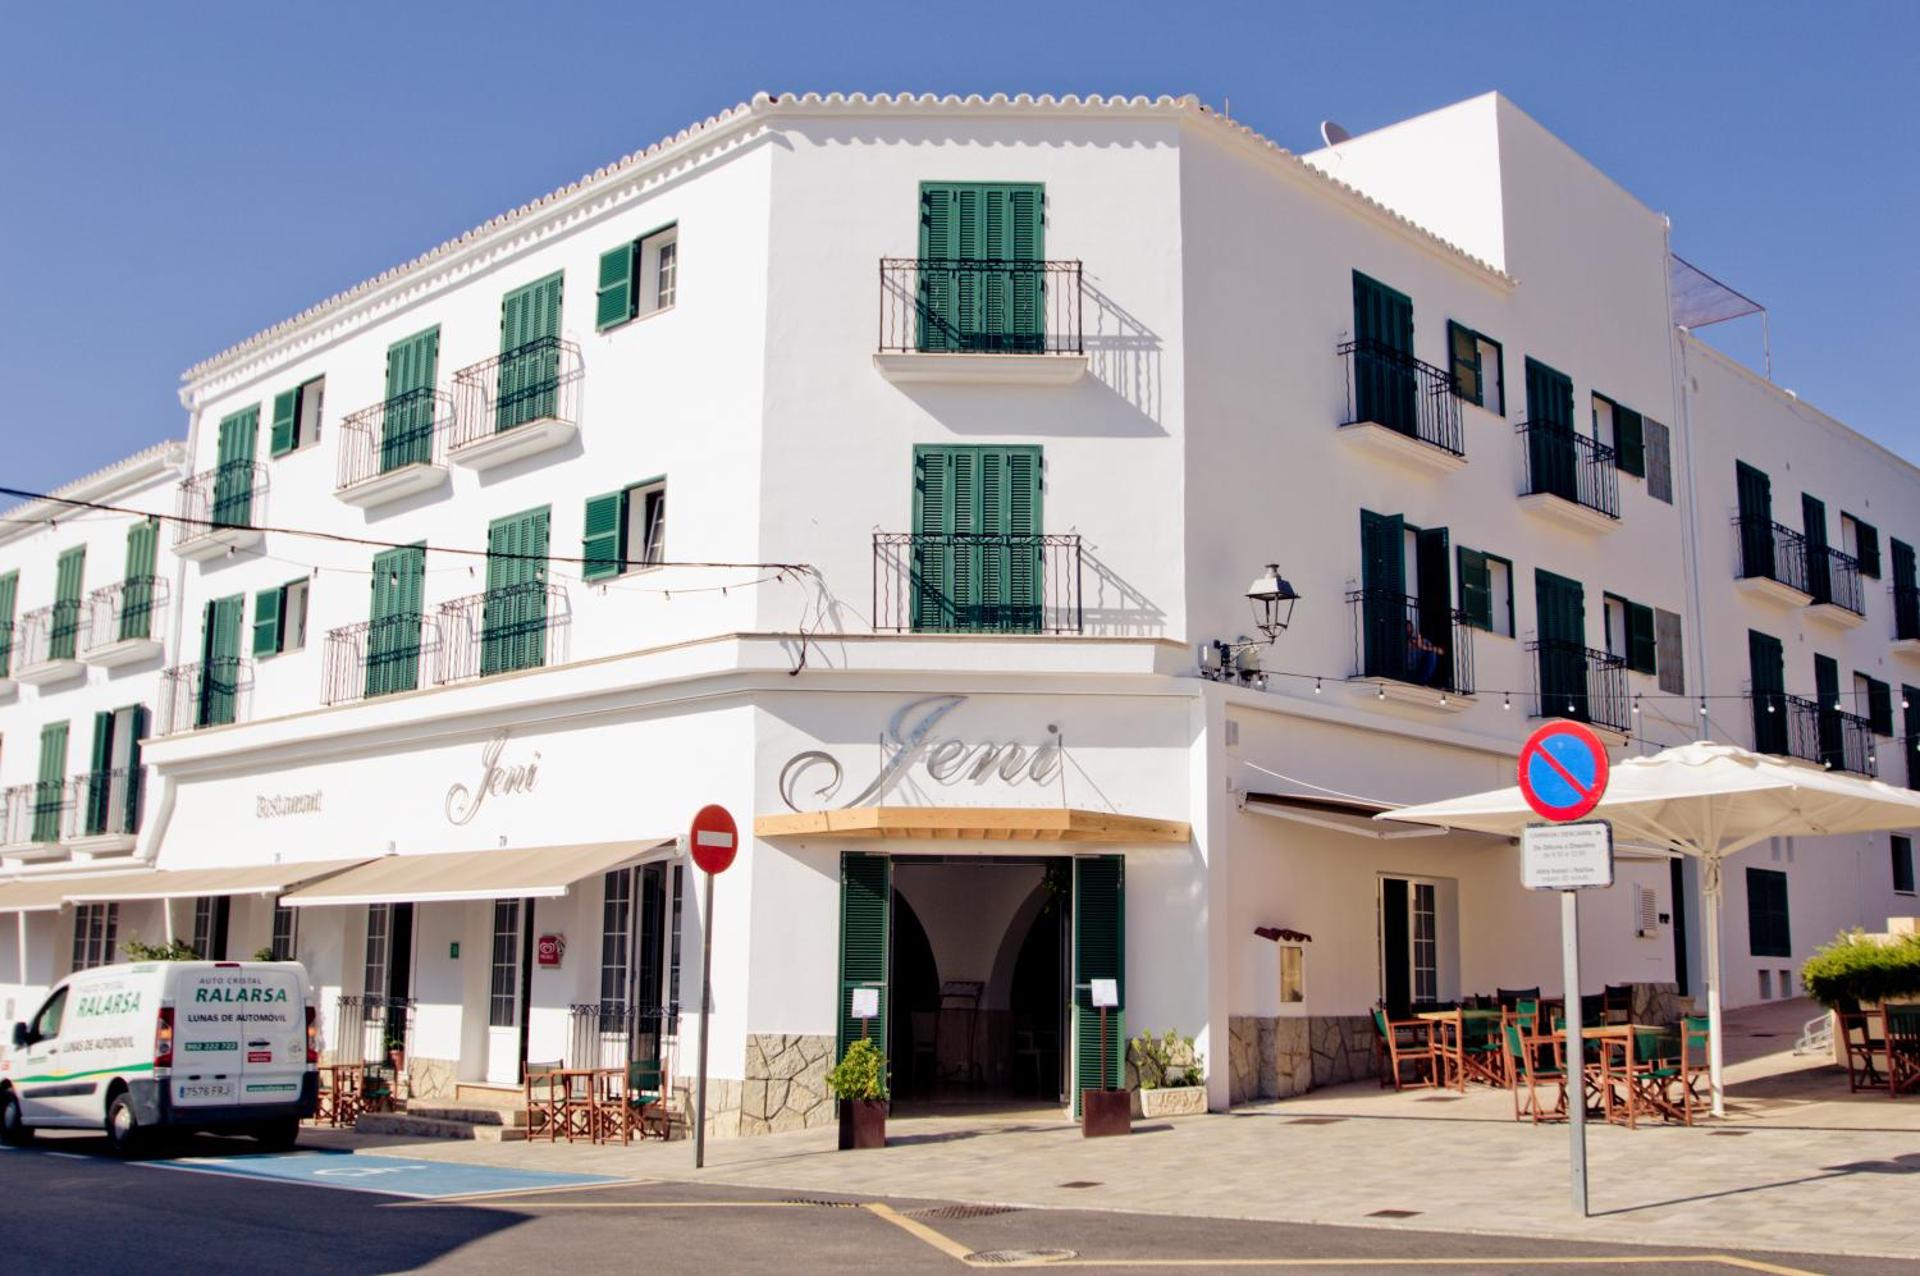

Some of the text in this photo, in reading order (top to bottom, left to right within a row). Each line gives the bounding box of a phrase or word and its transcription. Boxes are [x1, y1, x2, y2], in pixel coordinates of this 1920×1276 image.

[778, 694, 1062, 814] Jeni
[444, 729, 542, 827] Jeni
[199, 977, 262, 985] AUTO CRISTAL
[77, 990, 141, 1018] RALARSA
[196, 987, 288, 1003] RALARSA
[187, 1014, 219, 1023] LUNAS
[221, 1014, 234, 1022] DE
